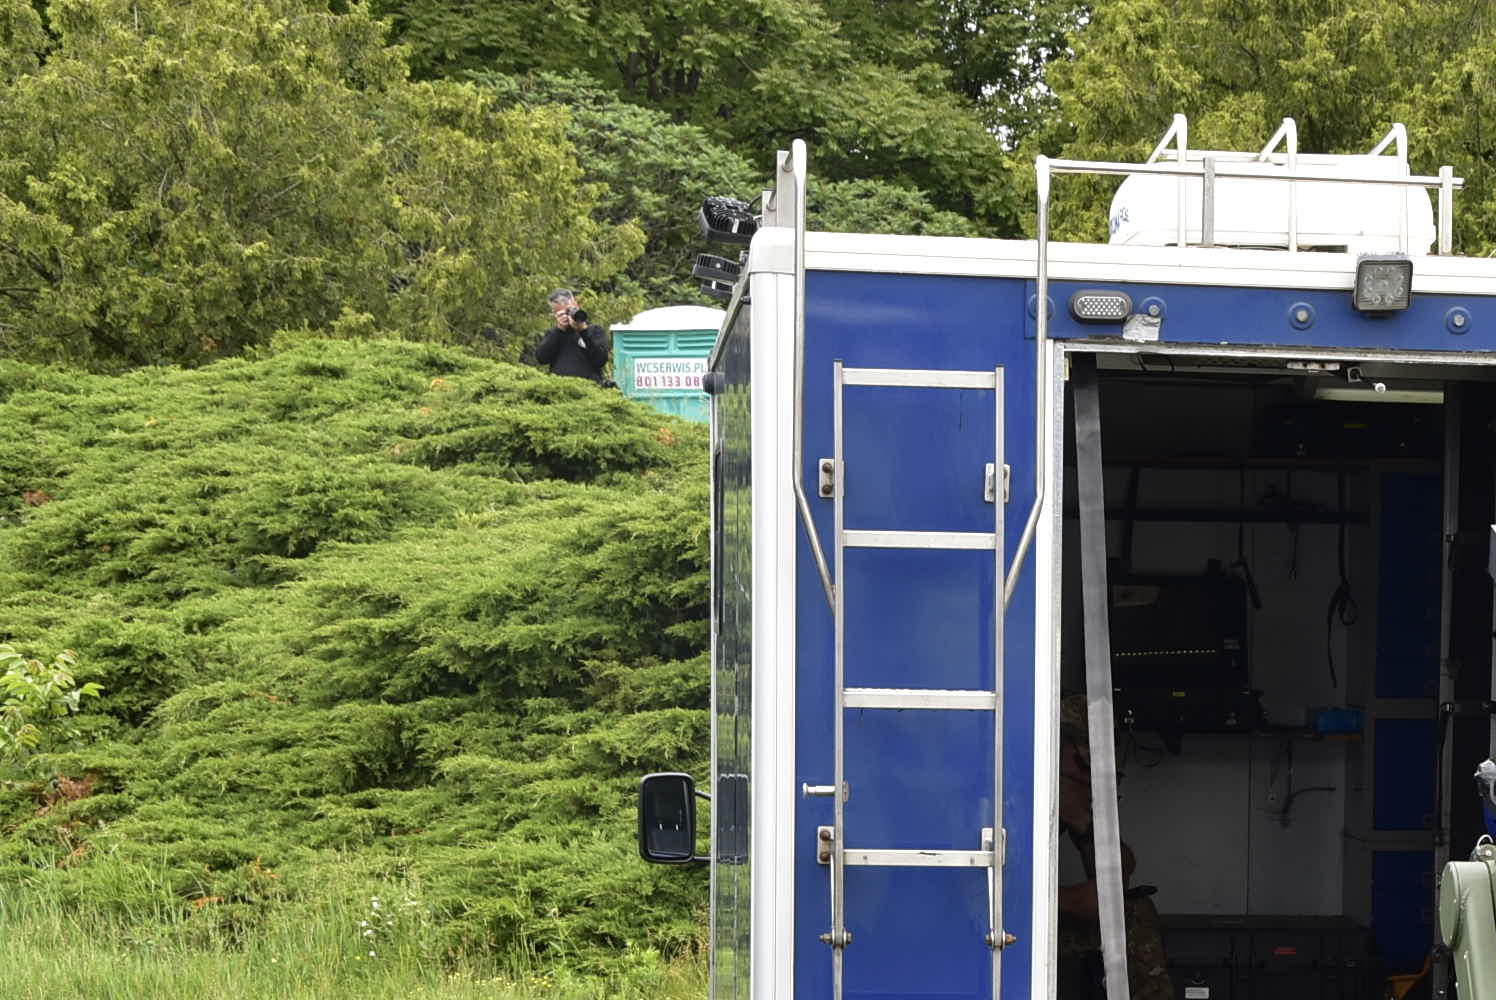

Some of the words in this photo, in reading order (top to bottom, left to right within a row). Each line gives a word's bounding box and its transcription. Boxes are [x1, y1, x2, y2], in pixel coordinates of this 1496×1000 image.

[636, 376, 657, 387] 801
[661, 376, 681, 387] 133
[685, 376, 704, 387] 08
